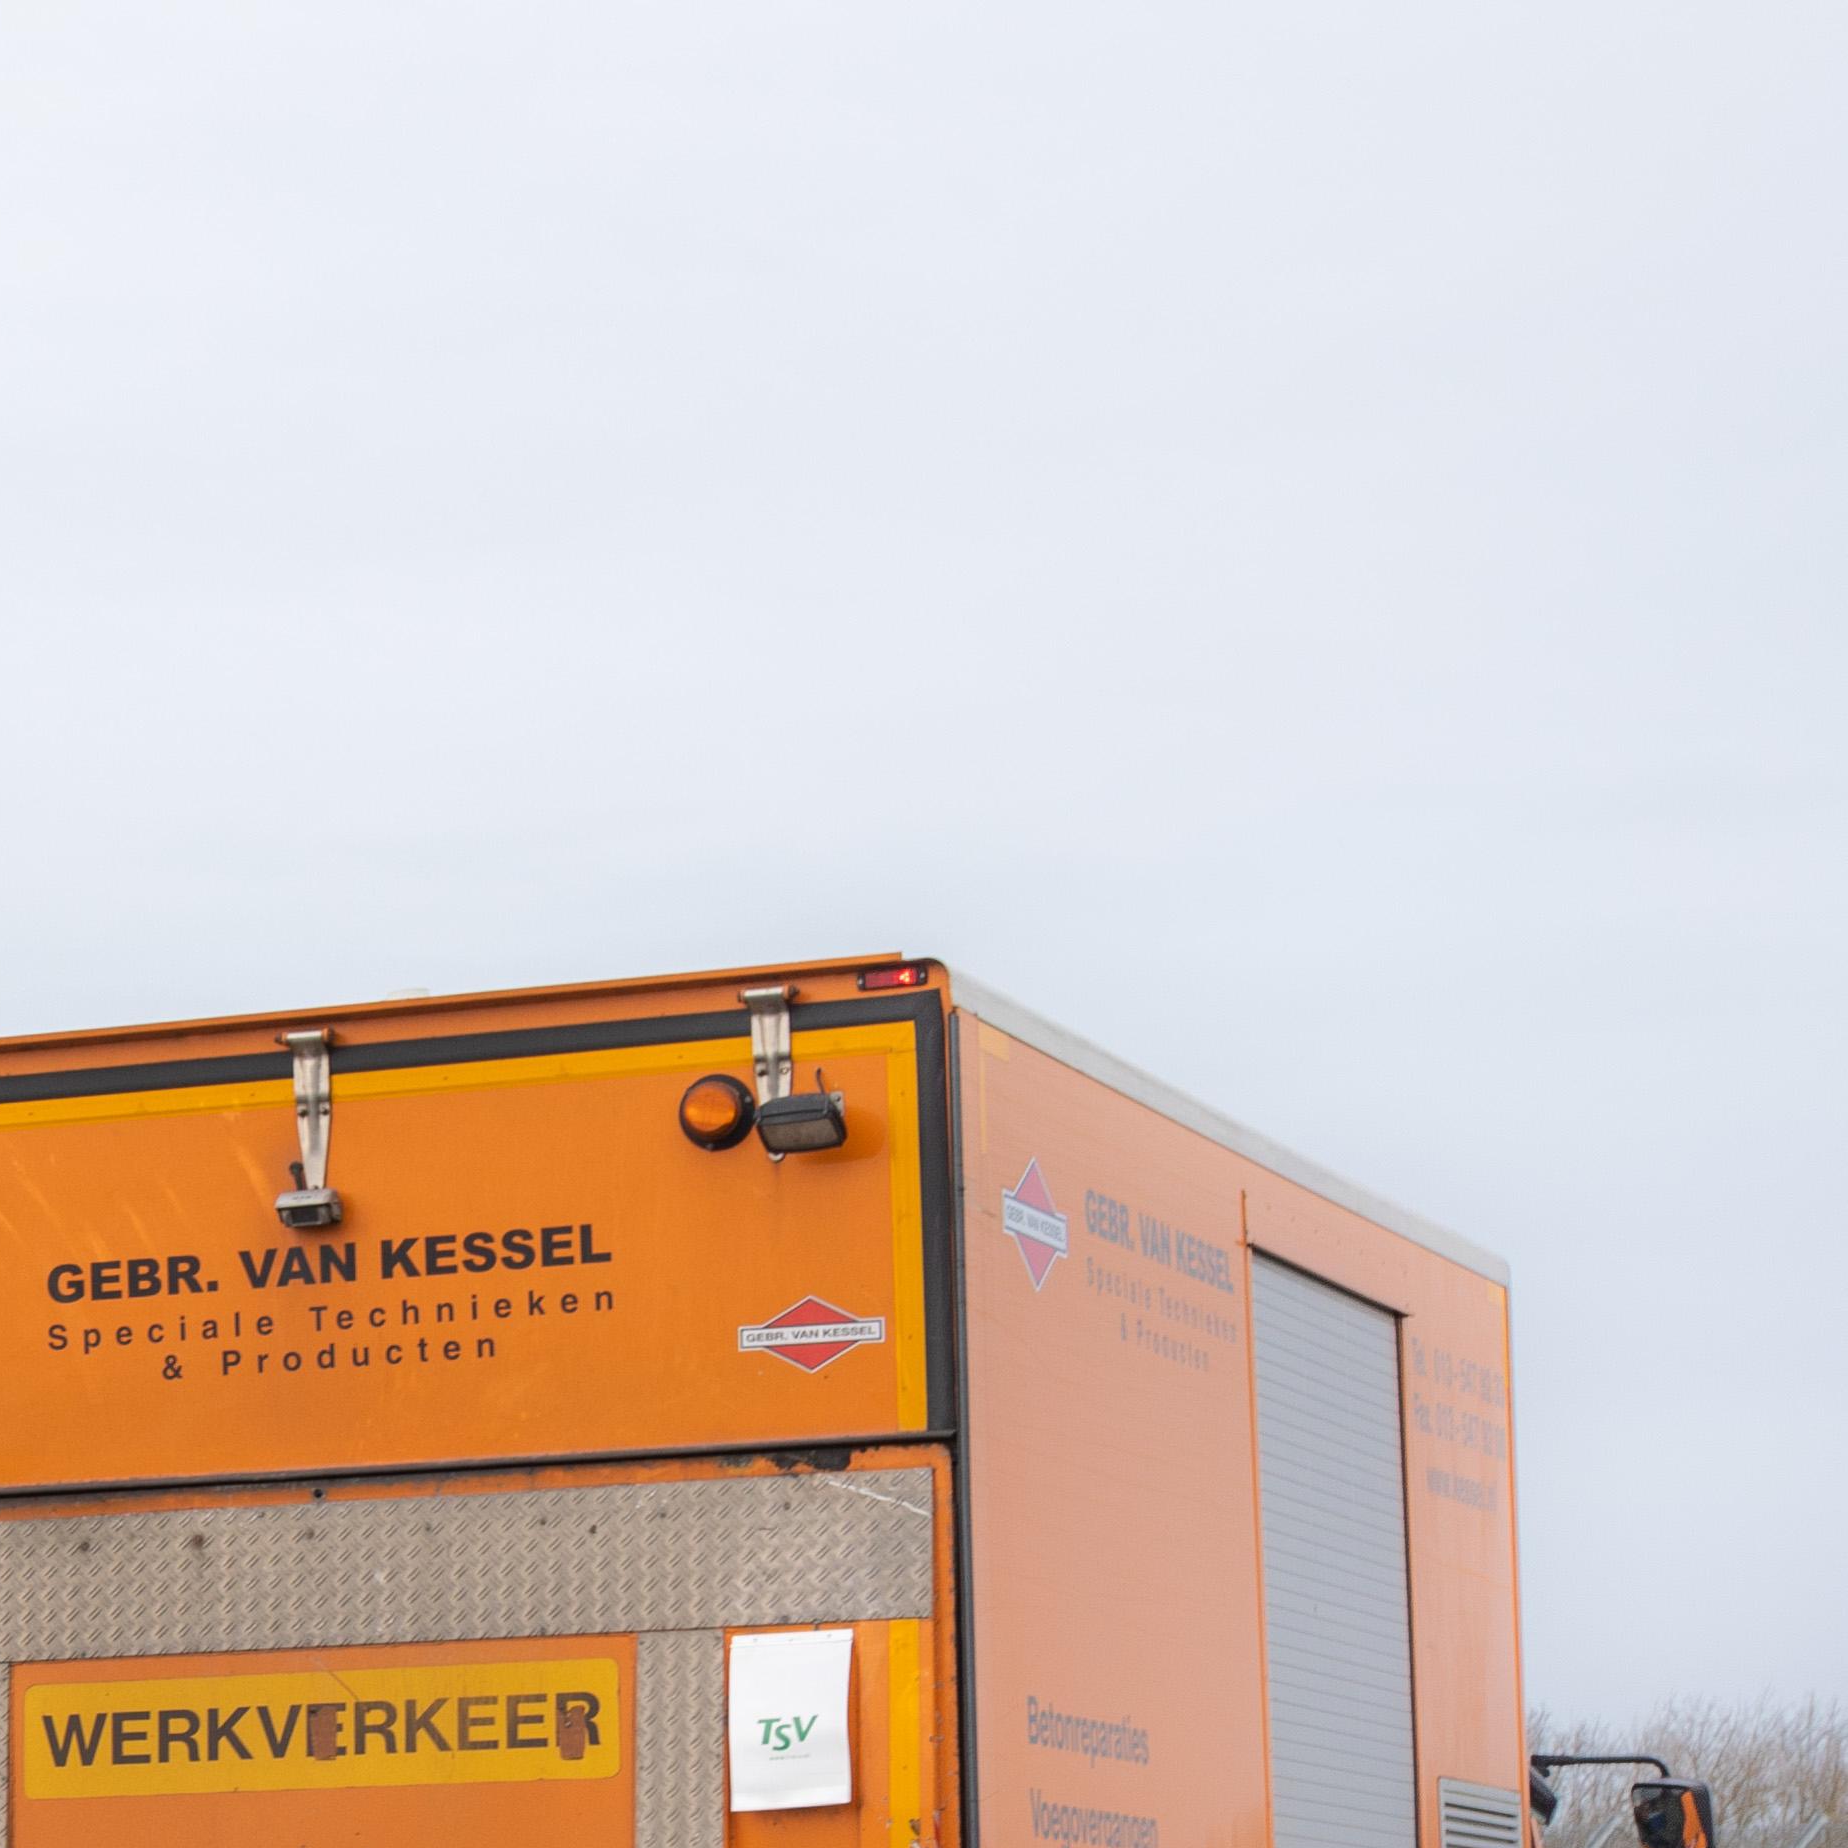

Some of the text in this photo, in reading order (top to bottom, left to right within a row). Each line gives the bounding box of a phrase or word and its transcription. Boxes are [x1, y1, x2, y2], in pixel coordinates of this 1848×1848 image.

[47, 1223, 613, 1303] GEBR. VAN KESSEL
[1085, 1189, 1235, 1295] GEBR. VAN KESSEL
[1085, 1256, 1152, 1310] Speciale
[48, 1289, 615, 1354] Speciale Technieken
[746, 1325, 876, 1343] GEBR. VAN KESSEL
[162, 1334, 496, 1380] & Producten
[42, 1691, 602, 1768] WERKVERKEER
[1027, 1695, 1150, 1769] Betonreparaties
